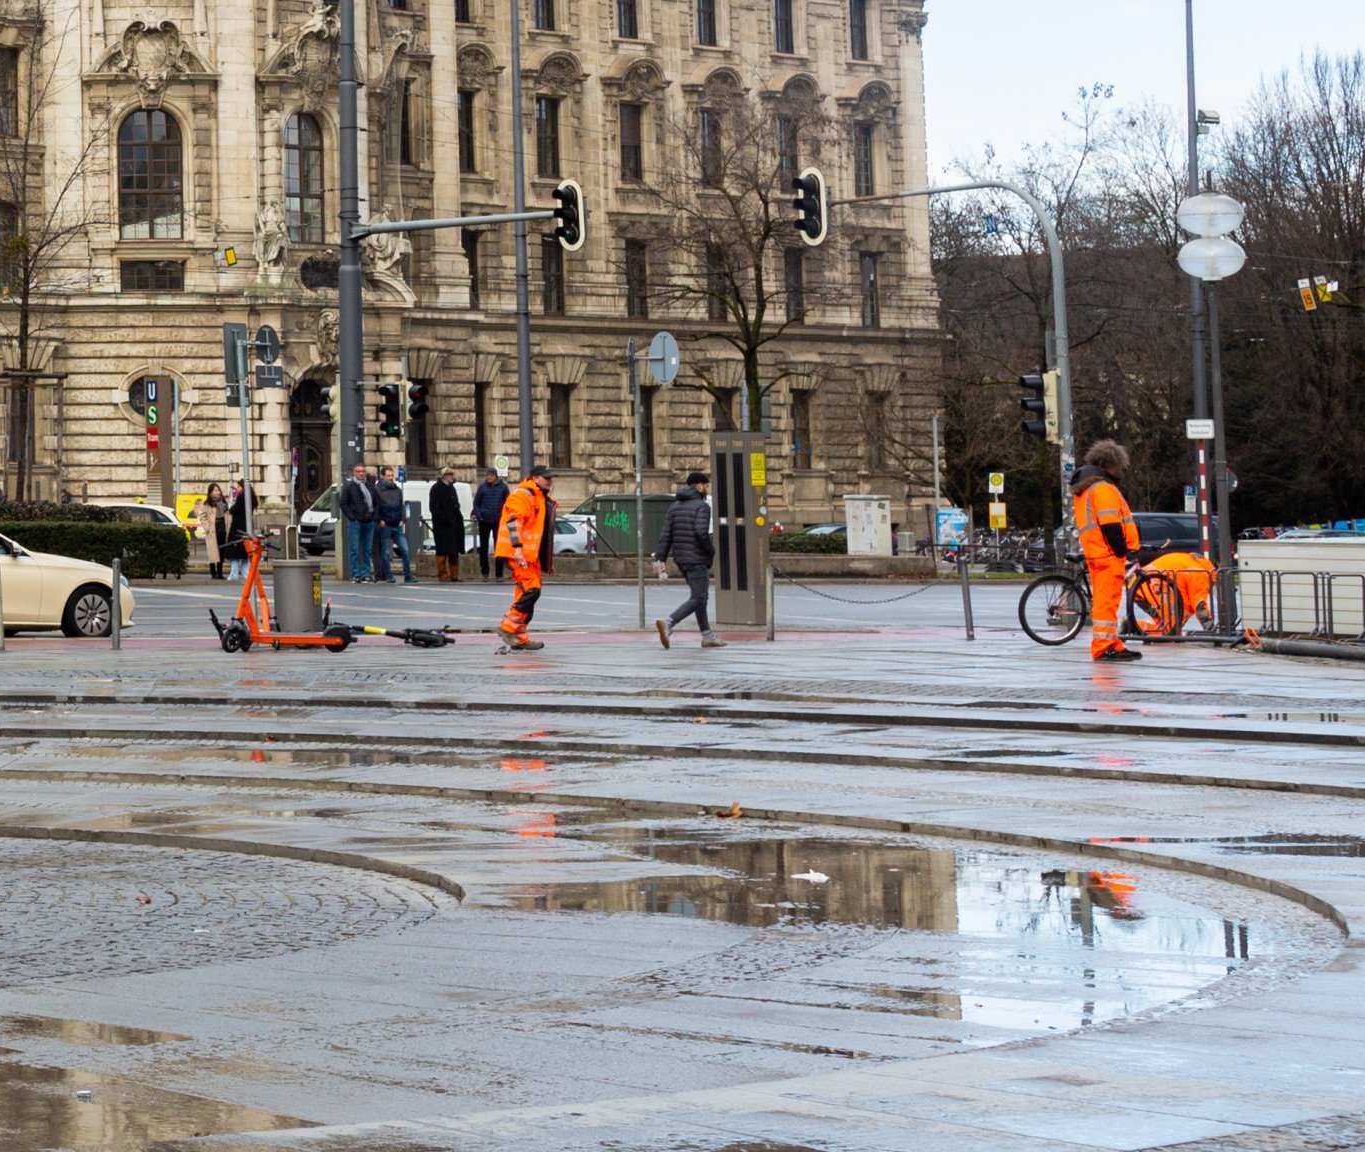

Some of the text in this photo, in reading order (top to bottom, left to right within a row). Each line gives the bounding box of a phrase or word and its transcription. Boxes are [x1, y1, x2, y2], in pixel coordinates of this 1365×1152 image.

[148, 383, 156, 400] U
[148, 406, 157, 424] S
[147, 433, 159, 442] Tram
